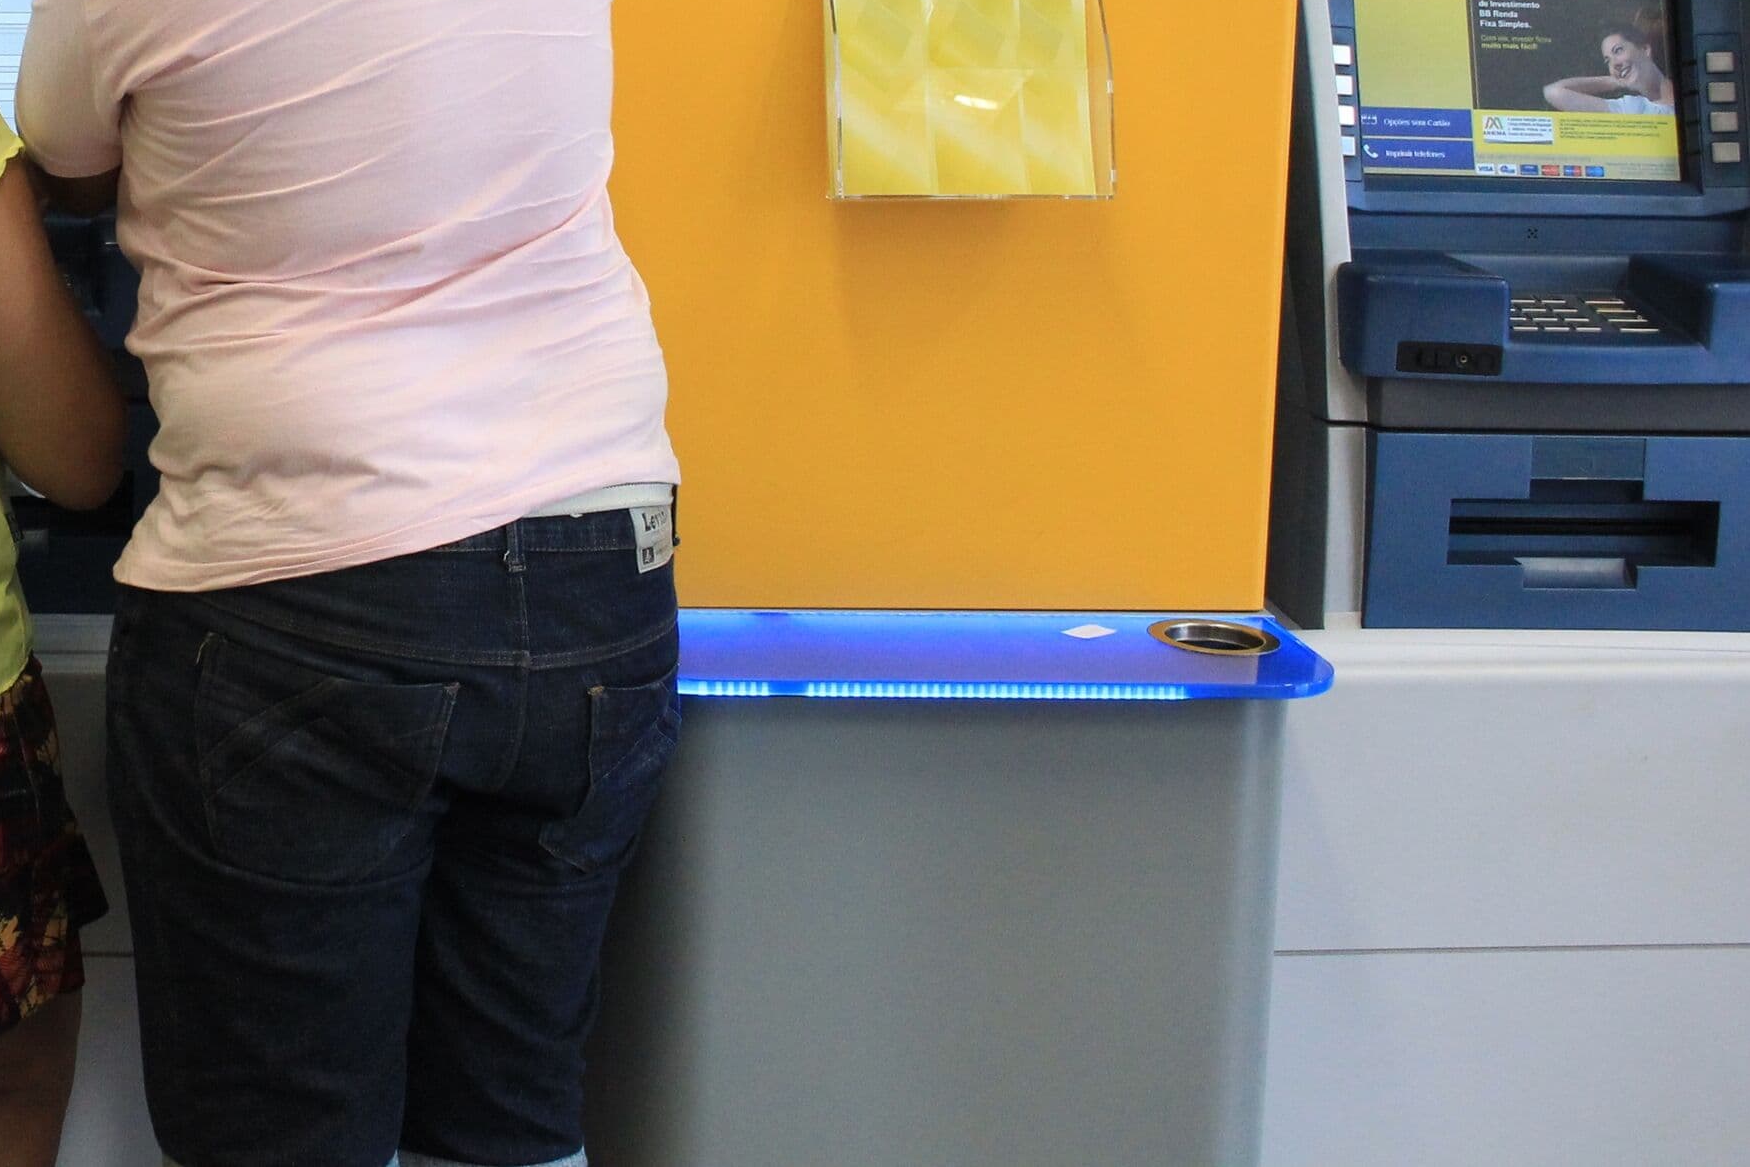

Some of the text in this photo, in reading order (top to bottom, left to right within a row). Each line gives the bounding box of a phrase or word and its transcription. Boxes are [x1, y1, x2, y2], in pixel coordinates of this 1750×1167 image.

[1489, 0, 1541, 9] Investimento
[1478, 9, 1518, 18] BB Renda
[1479, 19, 1532, 29] Fixa Simples.
[1383, 118, 1410, 127] Opções
[1478, 163, 1494, 172] VISA
